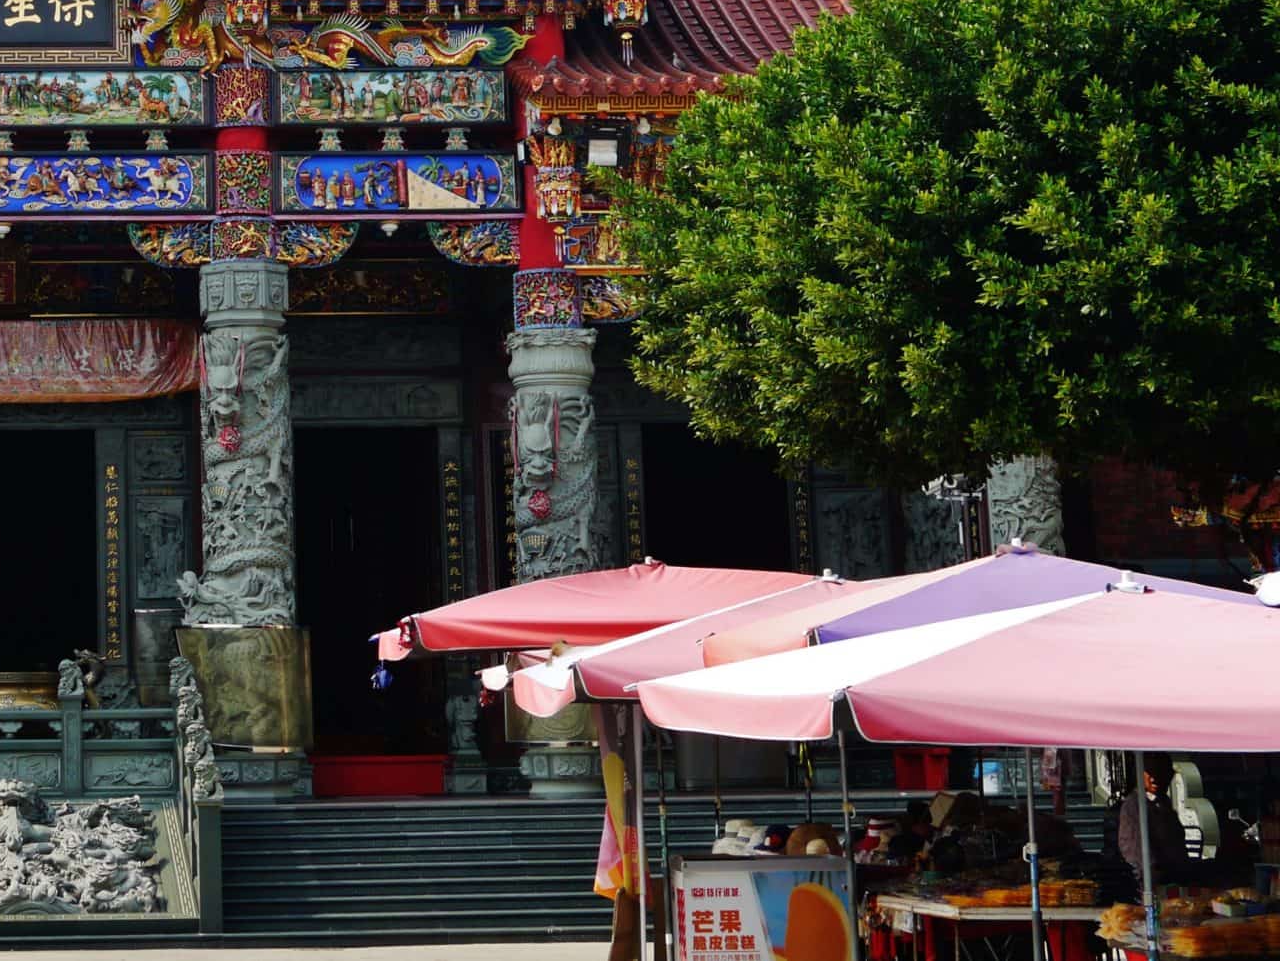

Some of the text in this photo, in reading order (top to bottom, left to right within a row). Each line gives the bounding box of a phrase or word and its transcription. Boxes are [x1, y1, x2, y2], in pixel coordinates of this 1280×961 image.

[692, 910, 742, 933] 芒果
[693, 935, 756, 951] 脆皮雪糕
